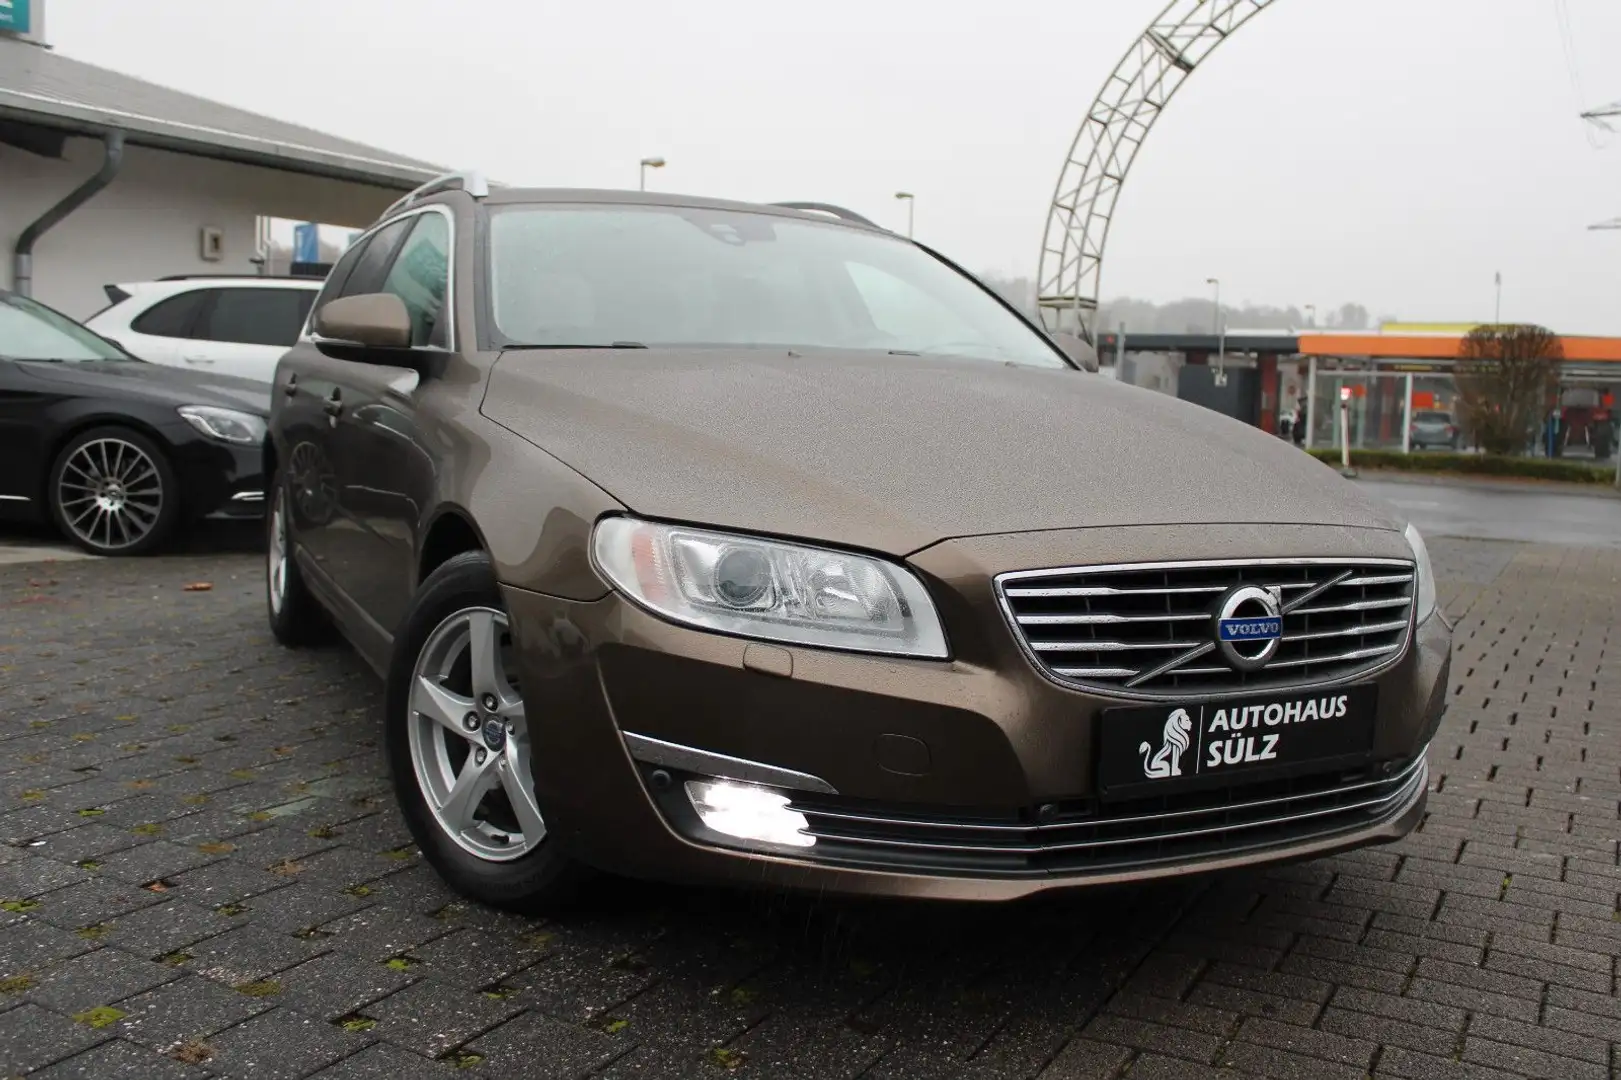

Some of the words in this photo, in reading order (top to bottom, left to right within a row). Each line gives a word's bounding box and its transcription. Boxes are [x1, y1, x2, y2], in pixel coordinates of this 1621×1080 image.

[1225, 622, 1279, 636] VOLVO
[1208, 695, 1348, 732] AUTOHAUS
[1206, 733, 1280, 767] SÜLZ
